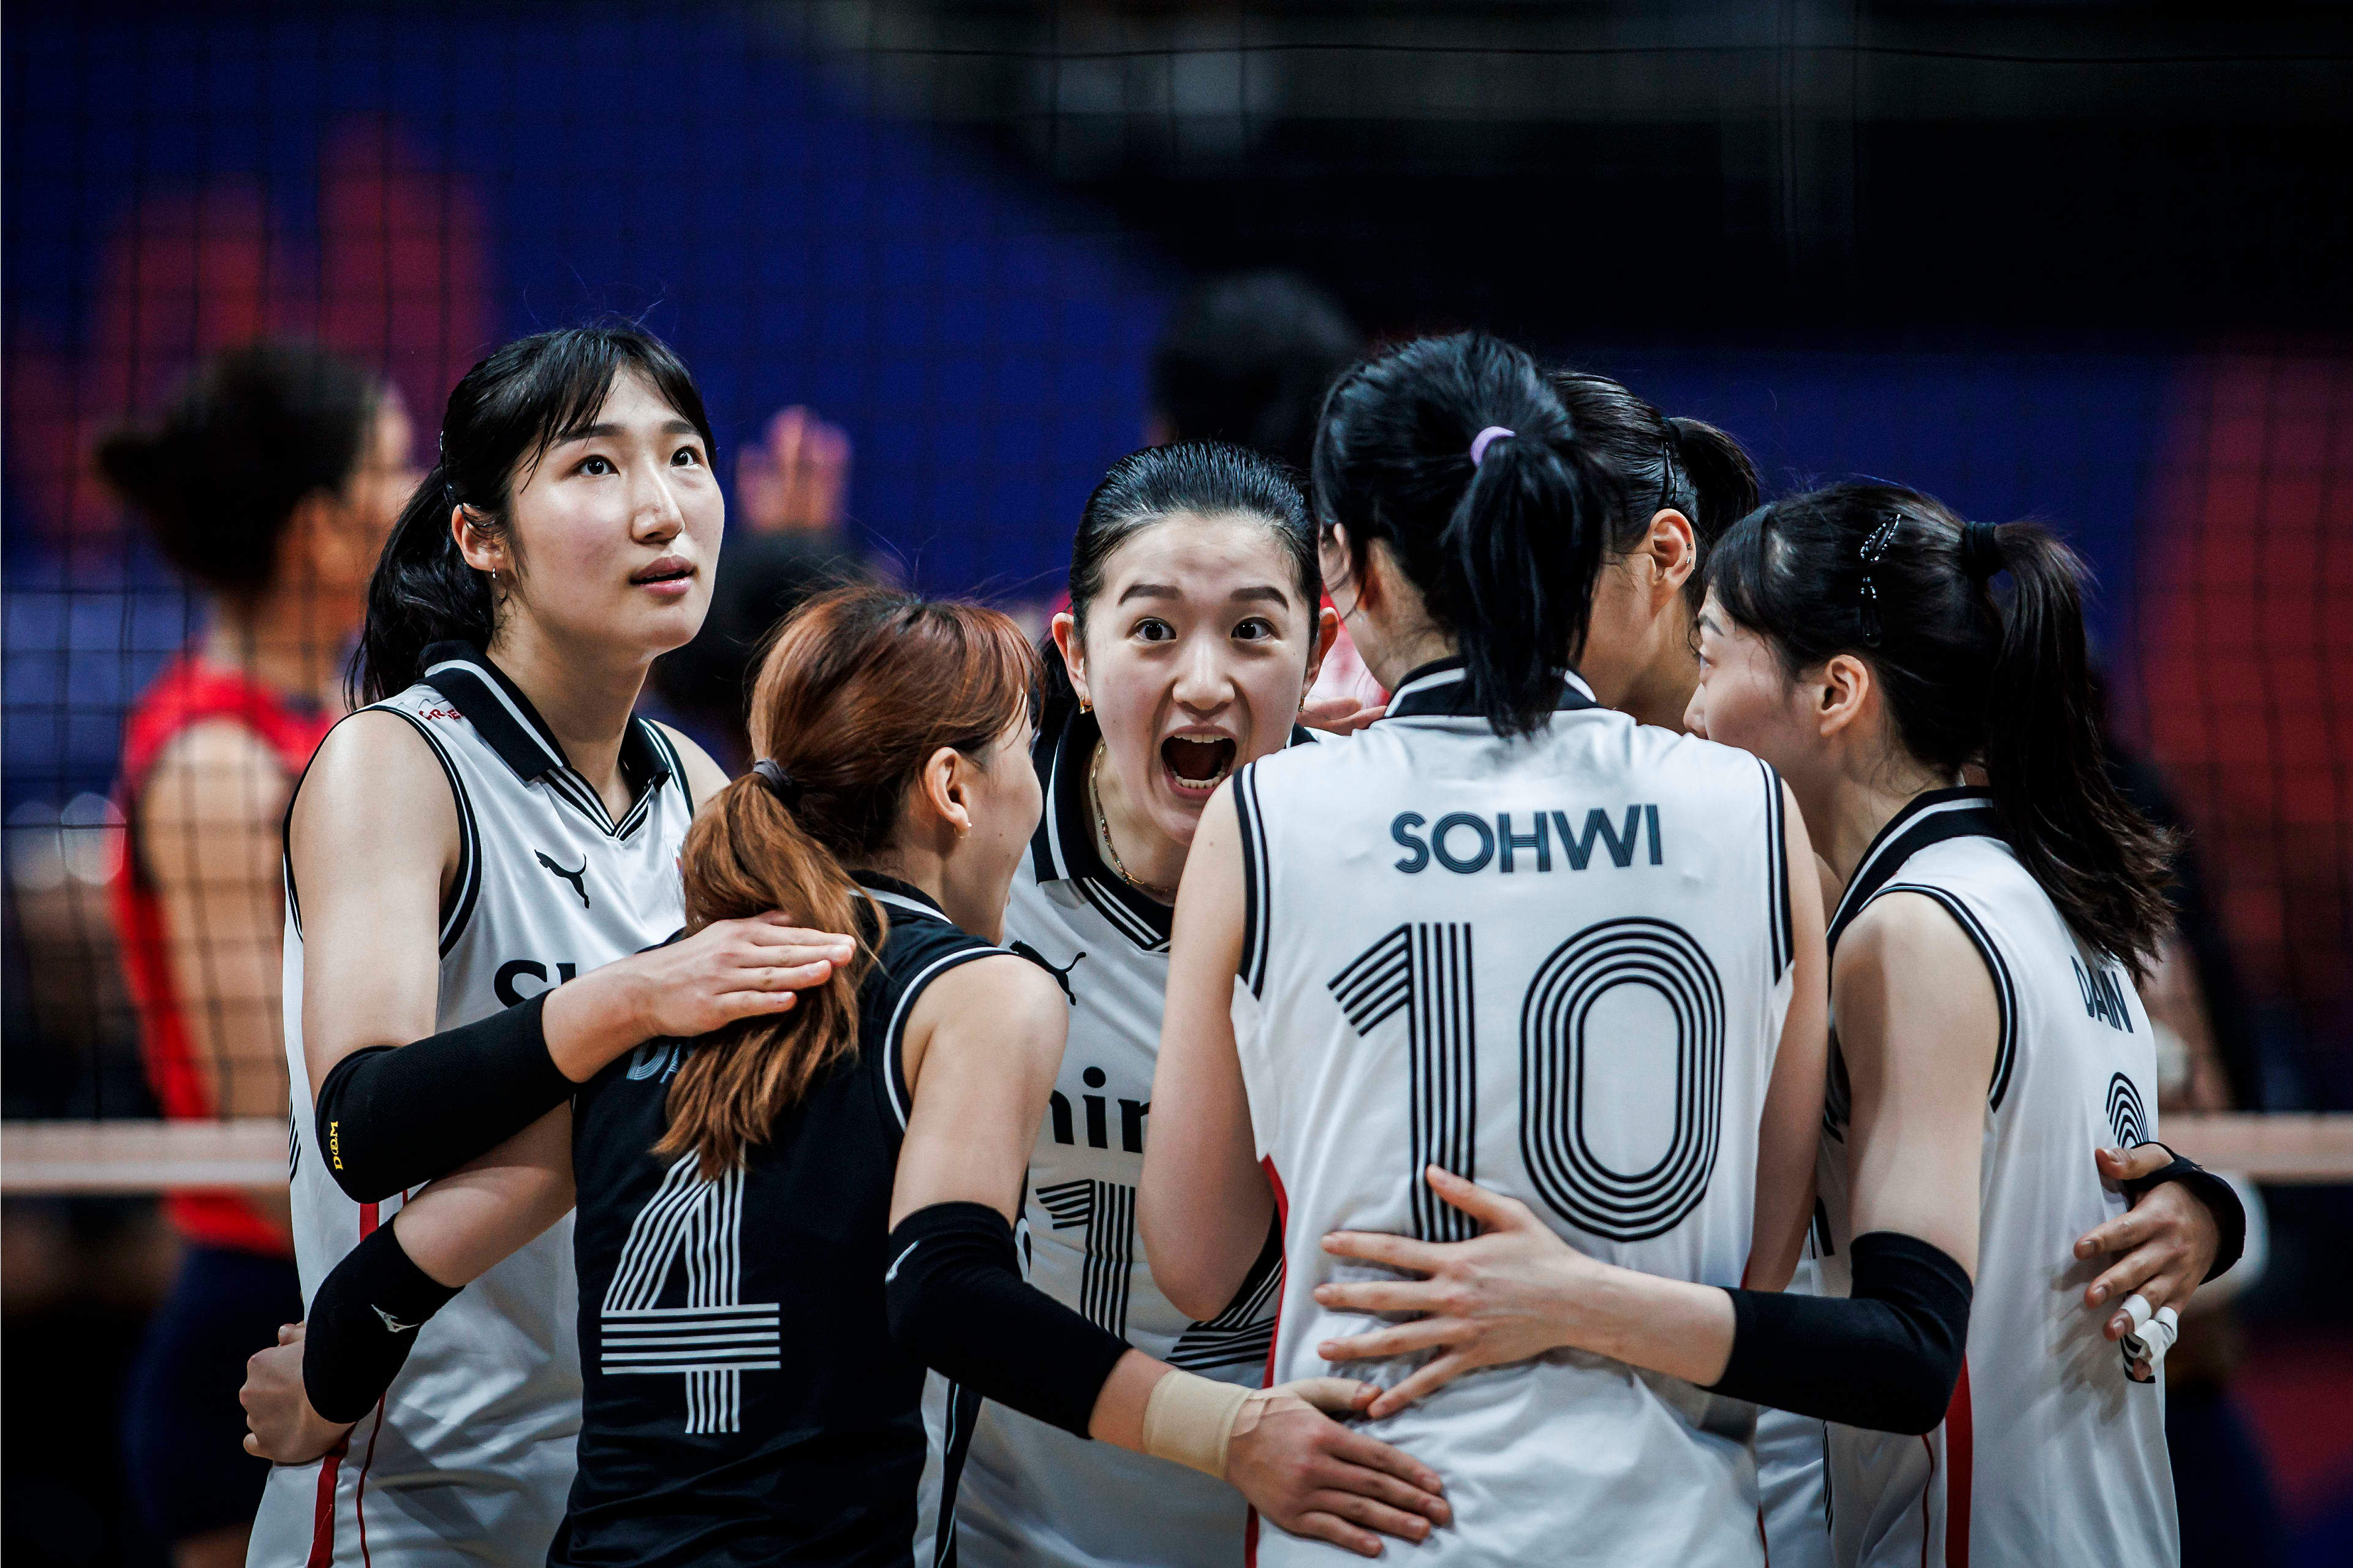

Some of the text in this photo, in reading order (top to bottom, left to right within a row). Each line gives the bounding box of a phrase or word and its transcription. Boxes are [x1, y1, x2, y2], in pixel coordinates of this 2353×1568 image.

[1390, 804, 1663, 874] SOHWI
[1328, 917, 1725, 1243] 10
[601, 1141, 781, 1433] 4
